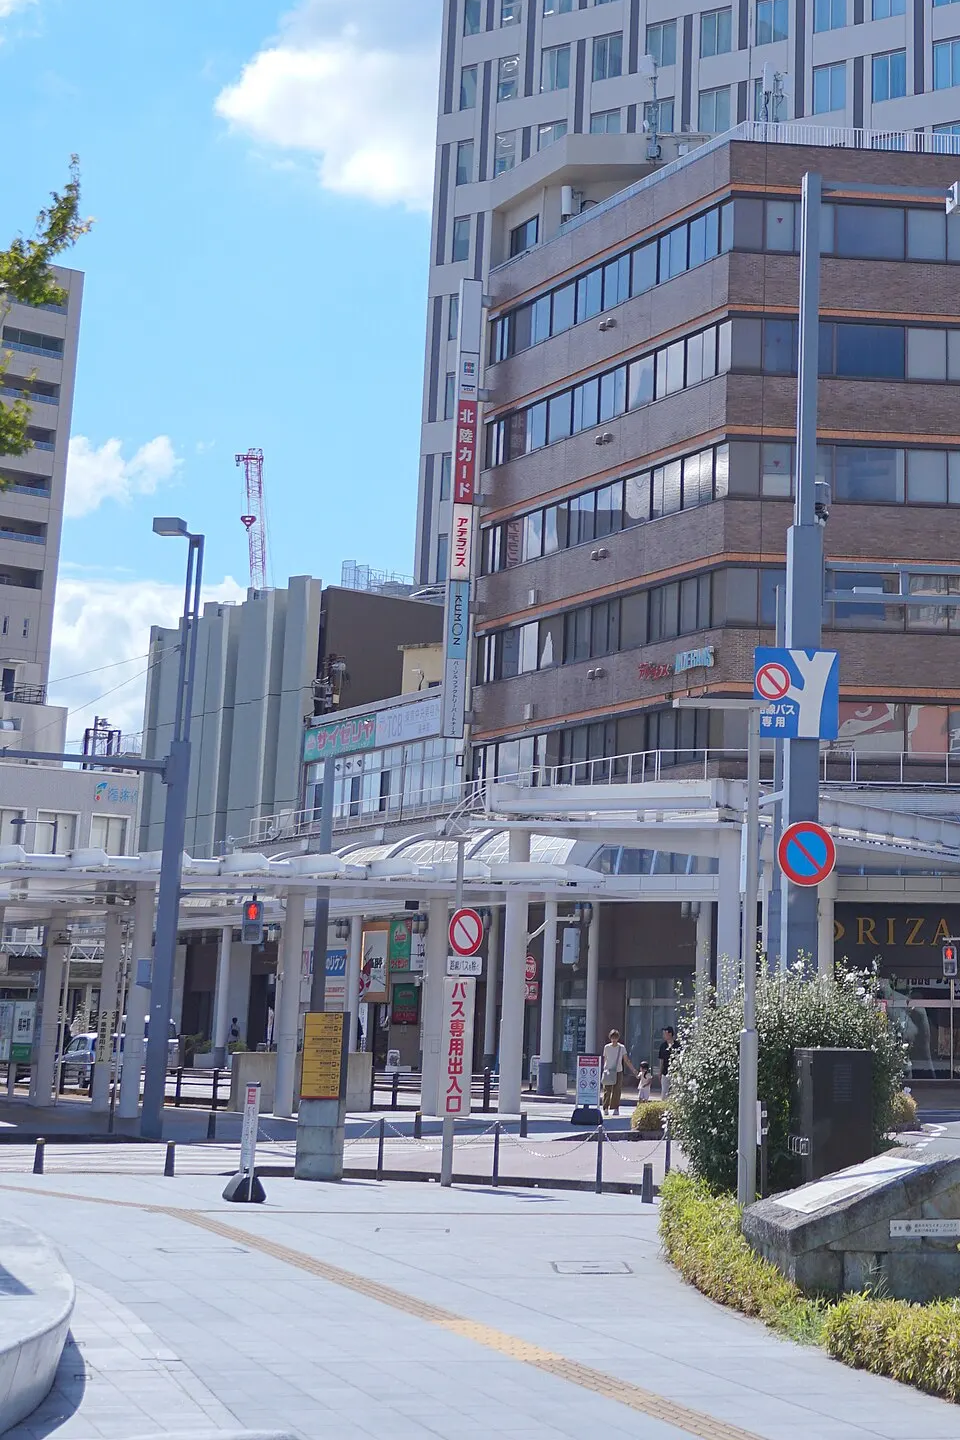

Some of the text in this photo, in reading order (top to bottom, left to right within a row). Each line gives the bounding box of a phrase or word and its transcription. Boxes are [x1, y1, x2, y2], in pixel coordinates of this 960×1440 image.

[458, 408, 474, 498] 北陸カード
[451, 595, 463, 646] KUMON
[317, 720, 376, 751] サイゼリヤ
[761, 716, 786, 728] 専用
[445, 981, 468, 1113] バス専用出入口
